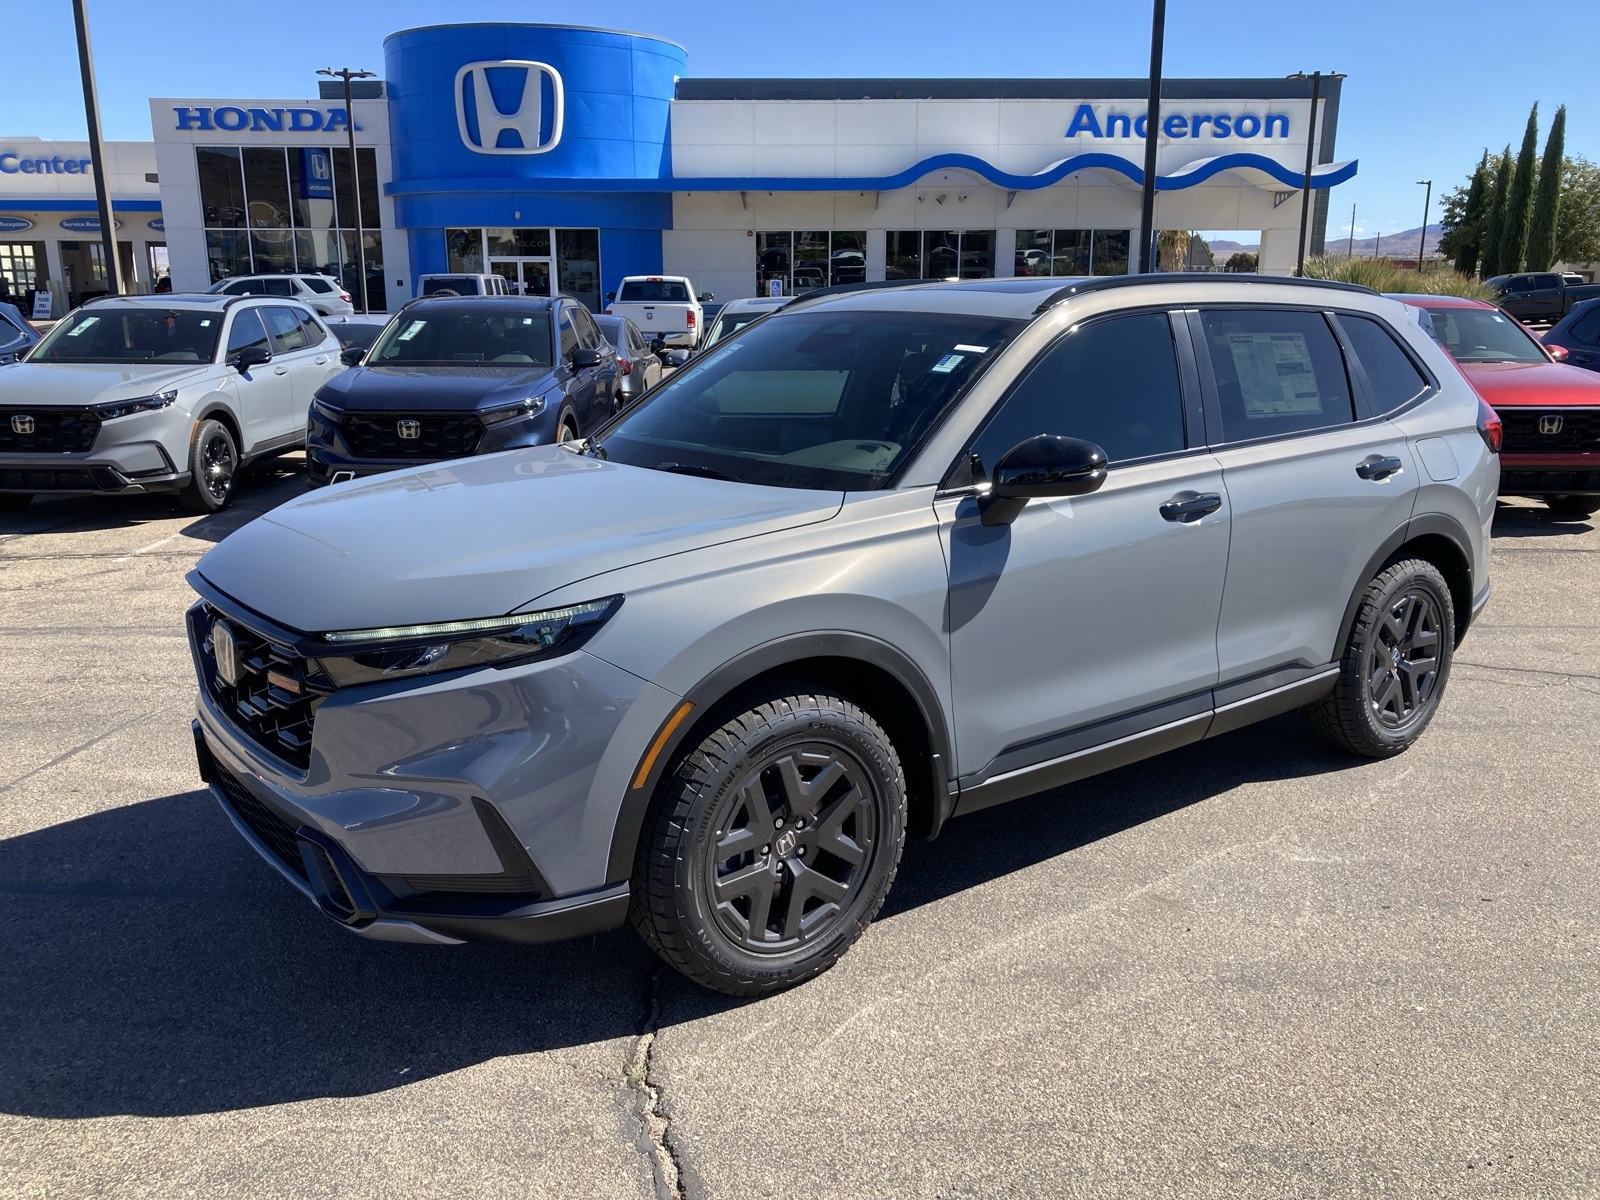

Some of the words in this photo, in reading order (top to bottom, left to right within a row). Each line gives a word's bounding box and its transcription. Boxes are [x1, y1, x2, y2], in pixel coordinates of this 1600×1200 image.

[173, 105, 362, 131] HONDA
[0, 153, 92, 175] Center
[696, 770, 737, 843] Continental
[697, 928, 792, 980] CONTINENTAL
